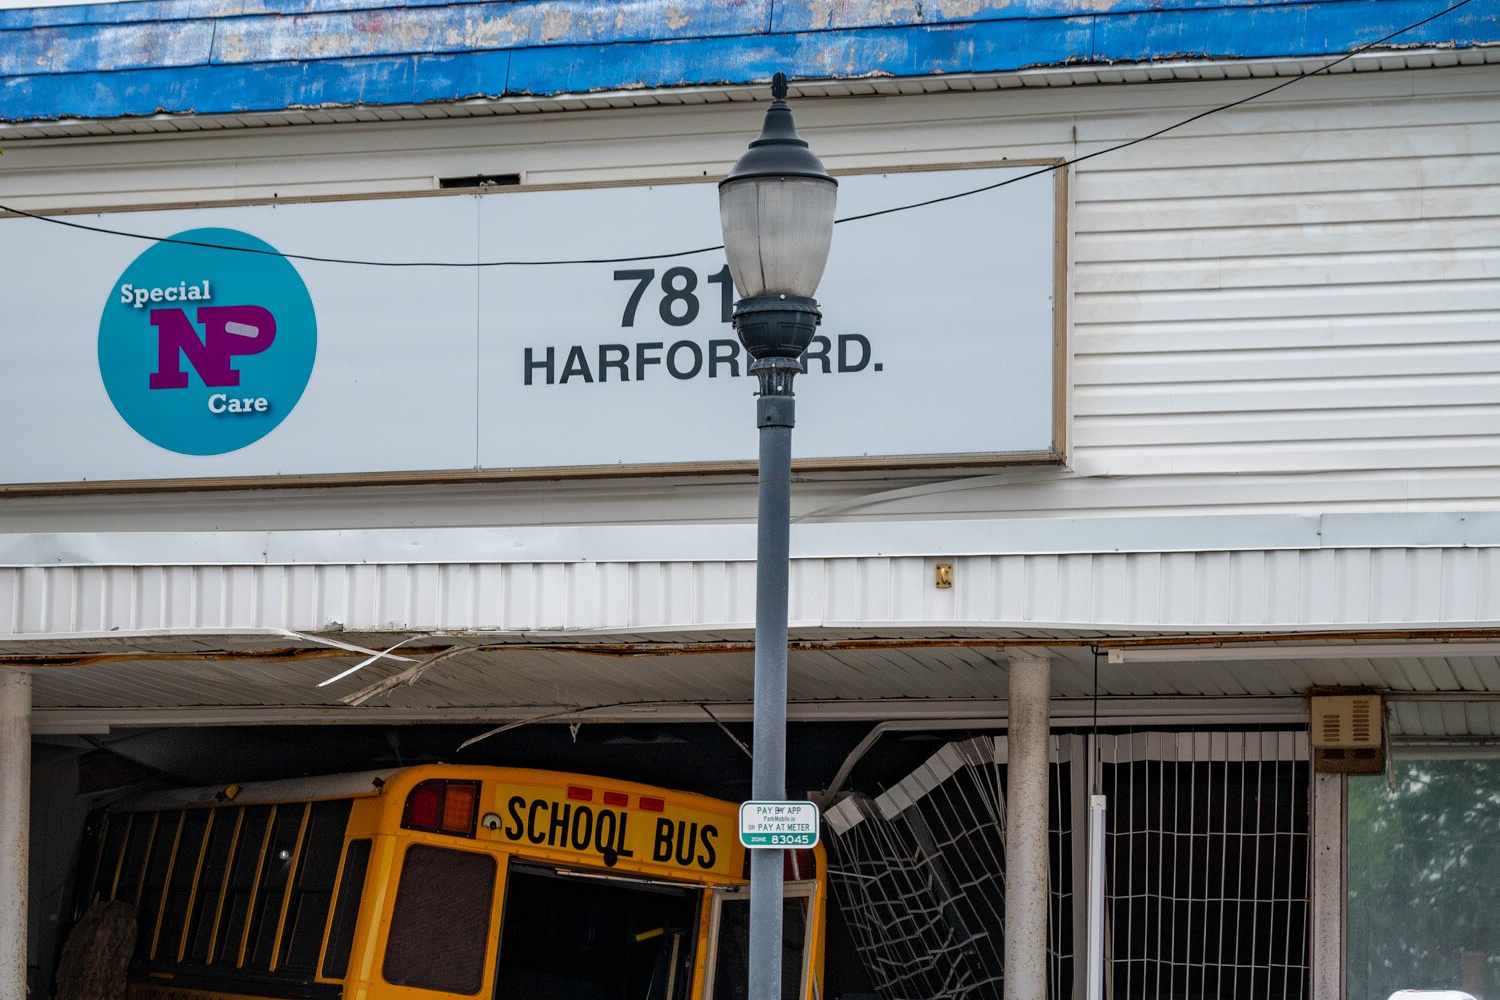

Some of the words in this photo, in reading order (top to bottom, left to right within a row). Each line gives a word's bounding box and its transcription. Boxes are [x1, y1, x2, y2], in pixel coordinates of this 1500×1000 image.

[120, 280, 211, 308] Special
[150, 305, 276, 389] NP
[524, 339, 755, 386] HARFOR
[801, 333, 883, 375] RD.
[208, 393, 268, 413] Care
[757, 806, 772, 815] PAY
[775, 806, 786, 815] BY
[787, 806, 801, 815] APP
[505, 796, 633, 858] SCHOOL
[652, 817, 719, 869] BUS
[758, 823, 774, 831] PAY
[775, 823, 785, 831] AT
[787, 823, 810, 832] METER
[771, 835, 809, 844] 83045
